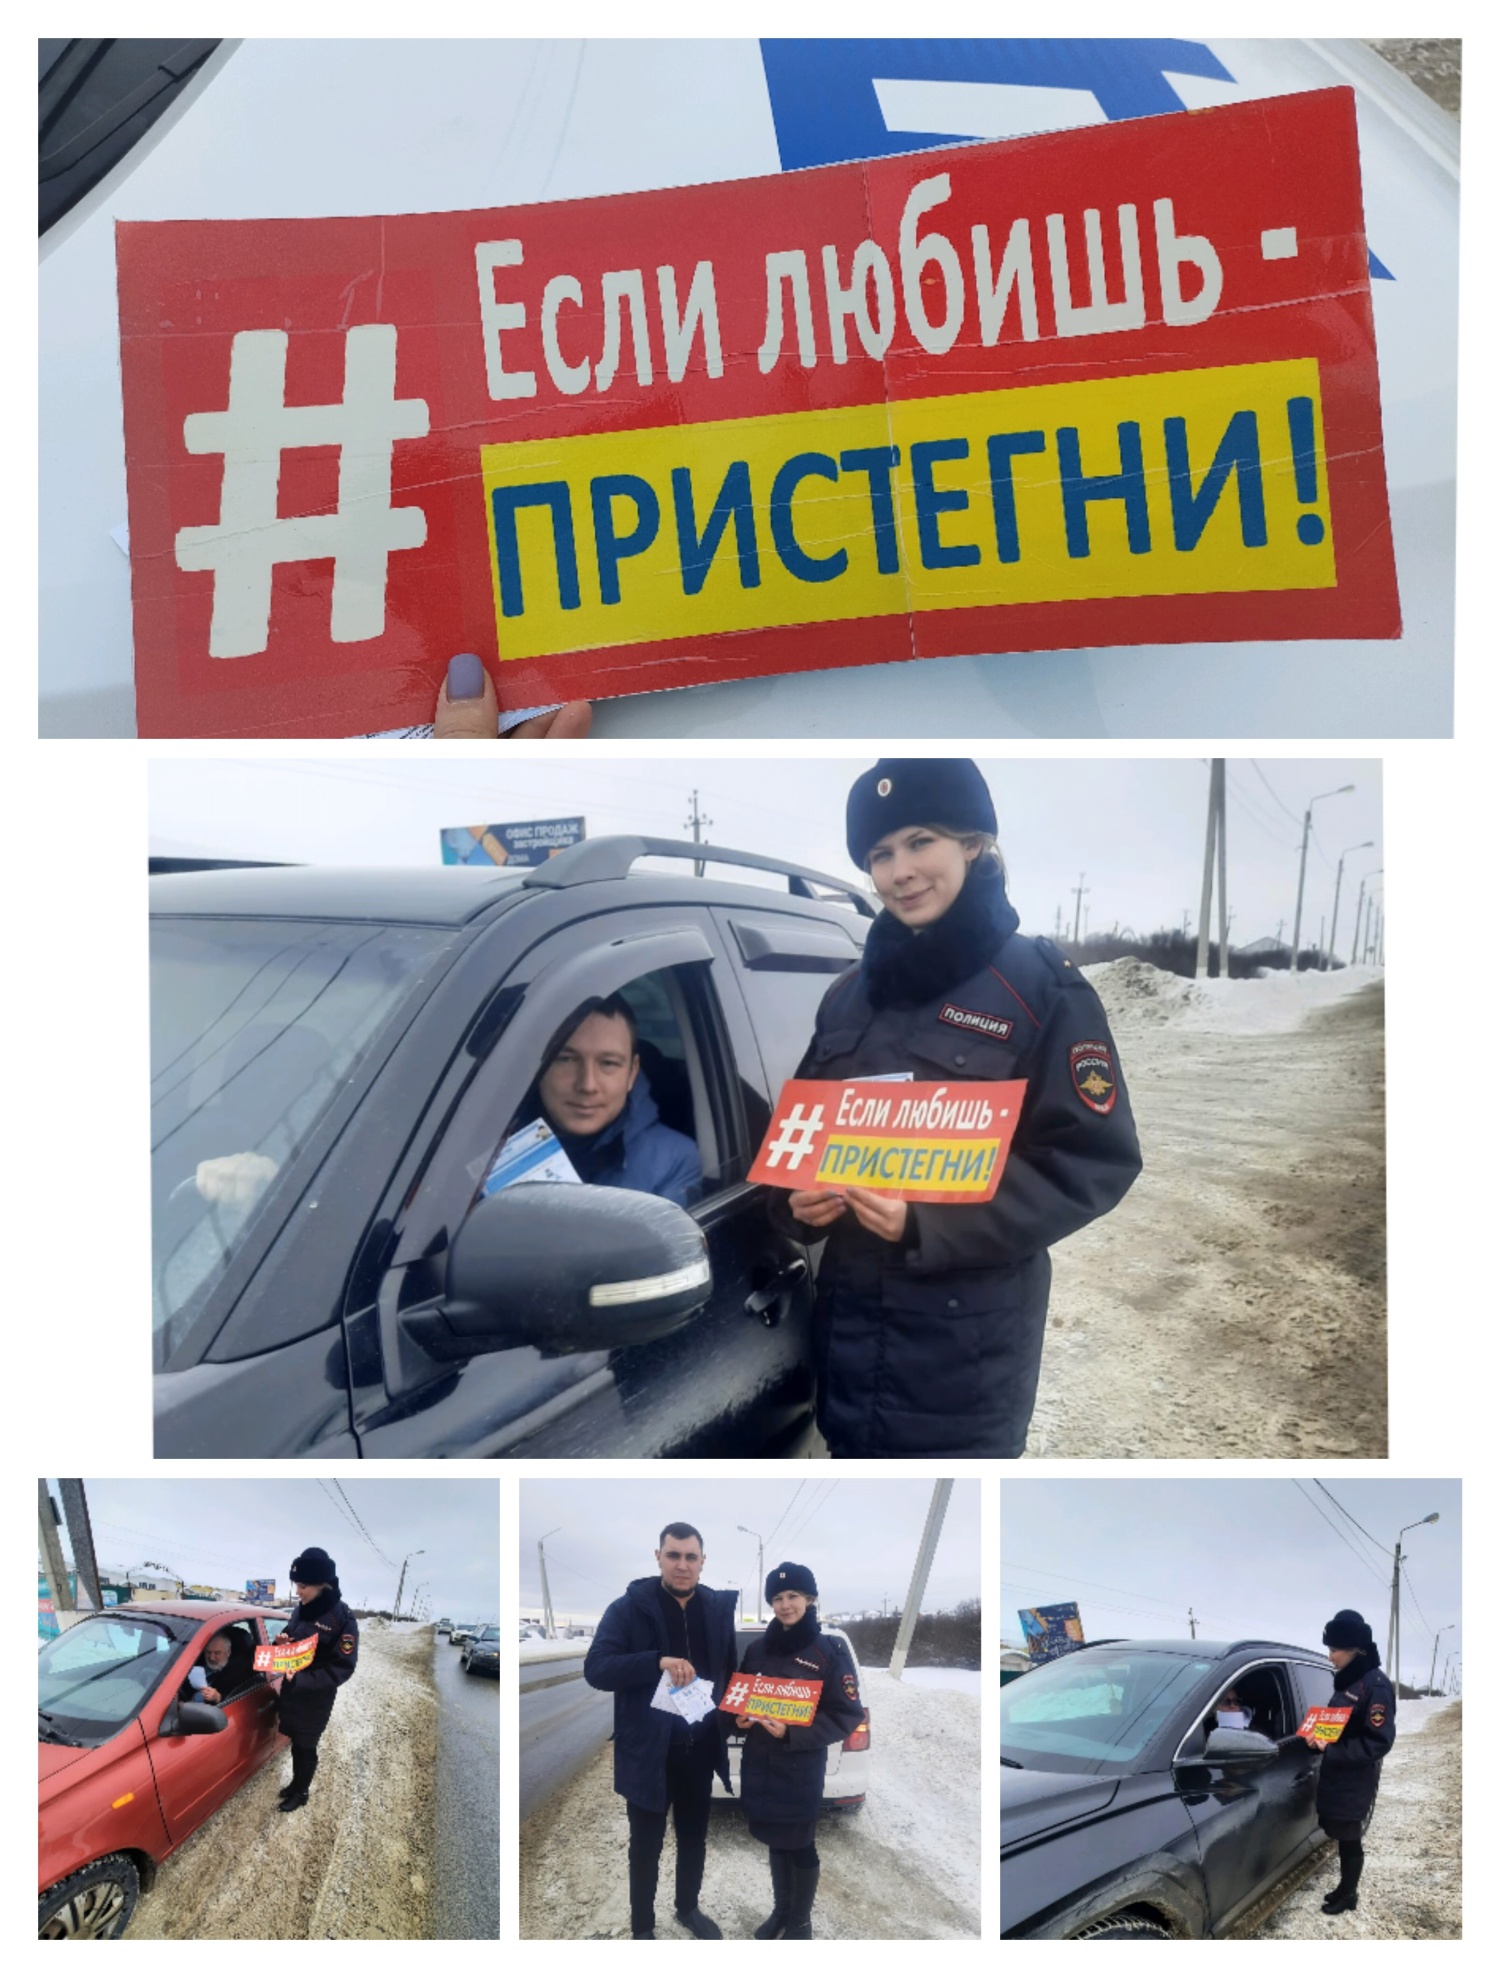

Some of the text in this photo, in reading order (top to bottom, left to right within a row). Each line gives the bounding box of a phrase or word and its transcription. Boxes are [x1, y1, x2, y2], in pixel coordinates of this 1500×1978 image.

[475, 173, 1298, 401] Если любишь -
[175, 324, 430, 659] #
[492, 396, 1326, 618] ПРИСТЕГНИ!
[506, 823, 579, 840] ОФИС ПРОДАЖ
[944, 1007, 1009, 1036] ПОЛИЦИЯ
[835, 1088, 891, 1127] Если
[892, 1087, 993, 1130] любишь
[766, 1103, 824, 1170] #
[819, 1143, 998, 1181] ПРИСТЕГНИ!
[726, 1682, 749, 1707] #
[746, 1698, 814, 1719] ПРИСТЕГНИ!
